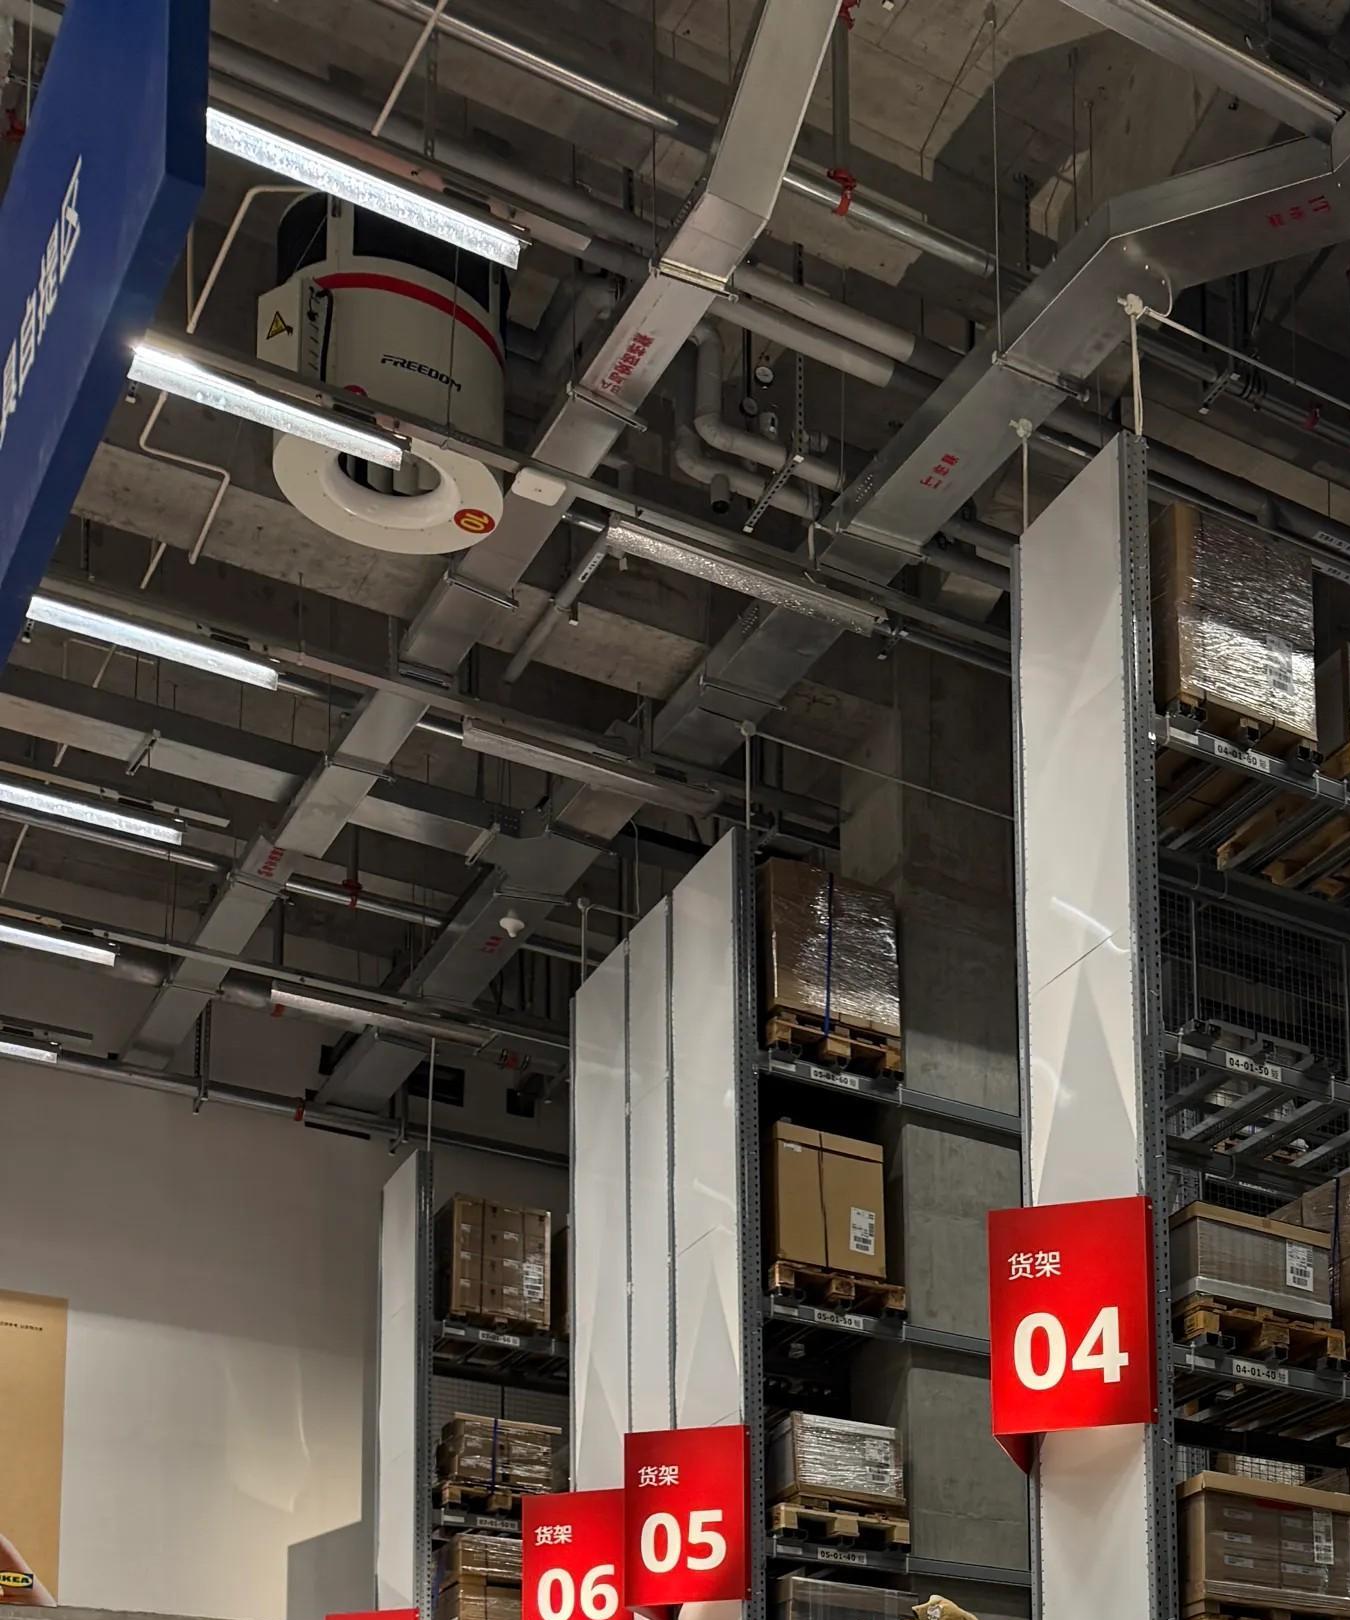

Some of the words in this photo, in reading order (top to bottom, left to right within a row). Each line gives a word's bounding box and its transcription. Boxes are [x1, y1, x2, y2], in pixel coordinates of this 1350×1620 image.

[380, 353, 462, 392] FREEDOM
[1229, 1057, 1269, 1076] 04-01-50
[1008, 1251, 1061, 1280] 货架
[1014, 1306, 1129, 1391] 04
[1235, 1364, 1277, 1380] 04-01-40
[638, 1465, 680, 1487] 货架
[534, 1525, 573, 1546] 货架
[640, 1509, 727, 1574] 05
[820, 1551, 856, 1562] 05-01-40
